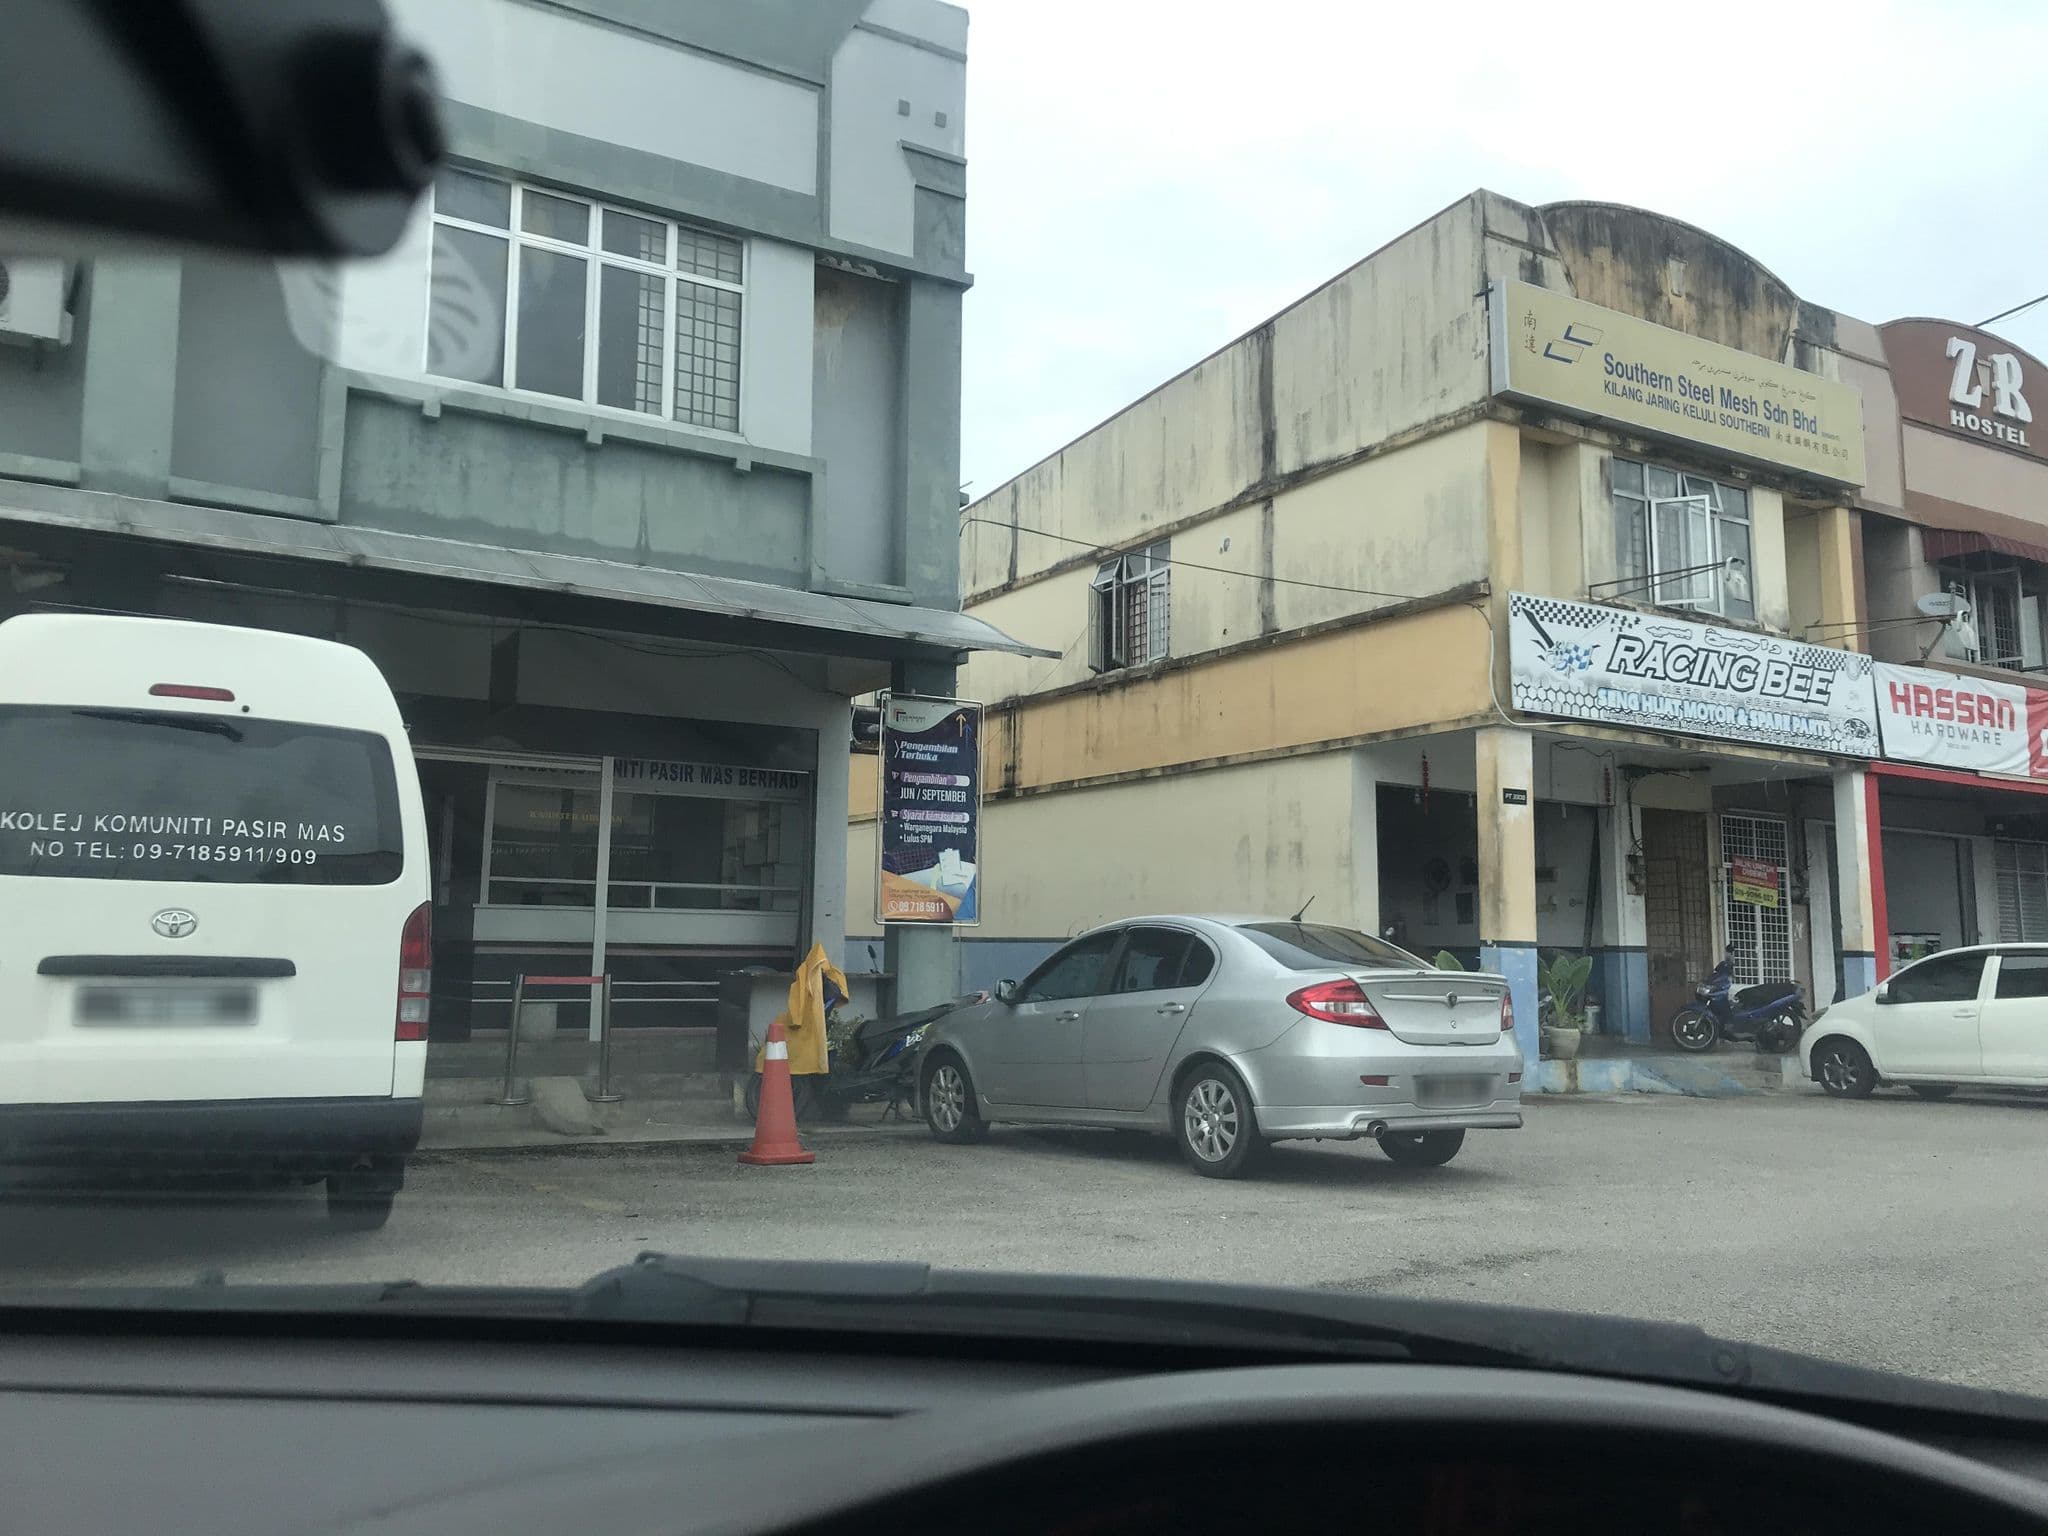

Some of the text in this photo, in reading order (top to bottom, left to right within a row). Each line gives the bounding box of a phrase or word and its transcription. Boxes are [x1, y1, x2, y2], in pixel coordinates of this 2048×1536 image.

[1603, 352, 1674, 393] Southern
[1678, 375, 1714, 405] Steel
[1720, 387, 1759, 417] Mesh
[1764, 399, 1789, 426] Sdn
[1793, 409, 1818, 435] Bhd
[1604, 380, 1771, 439] KILANG JARING KELULI SOUTHERN
[1950, 409, 2030, 447] HOSTEL
[1606, 634, 1760, 692] RACING
[1760, 658, 1836, 706] BEE
[1597, 687, 1640, 713] SENG
[1682, 696, 1735, 723] MOTOR
[1736, 706, 1748, 727] &
[1791, 714, 1831, 738] PARTS
[1889, 681, 2015, 732] HASSAN
[900, 740, 959, 753] Pengambilan
[1911, 720, 2002, 746] HARDWARE
[901, 750, 938, 761] Terbuka
[649, 761, 694, 782] PASIR
[700, 764, 732, 785] MAS
[739, 767, 799, 789] BERHAD
[903, 772, 947, 785] Pengambilan
[900, 787, 915, 800] JUN
[922, 789, 967, 803] SEPTEMBER
[0, 812, 345, 842] KOLEJ KOMUNITI PASIR MAS
[920, 835, 933, 843] SPM
[943, 824, 967, 835] Malaysia
[30, 841, 317, 864] NO TEL: 09-7185911/909
